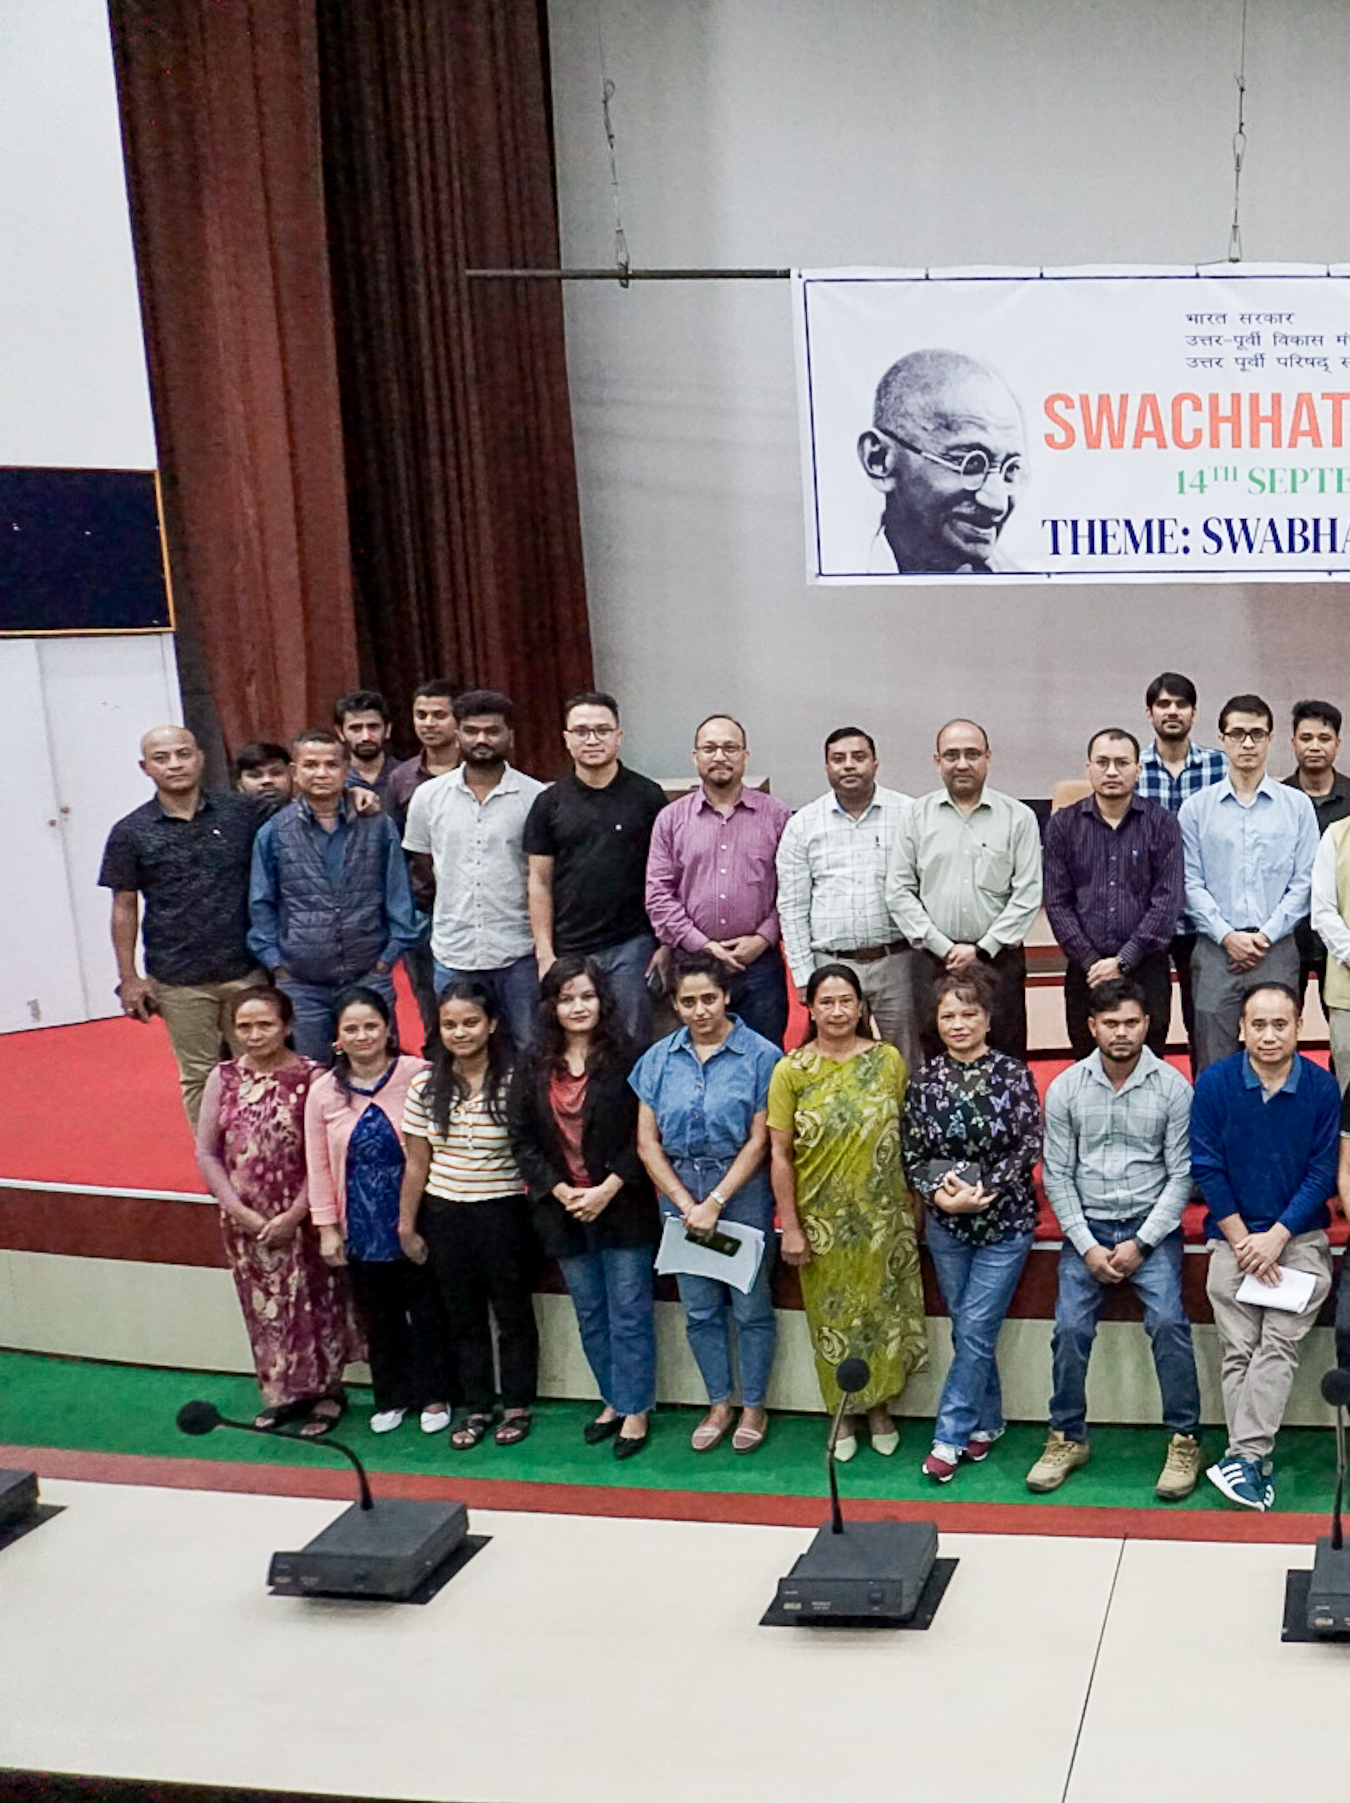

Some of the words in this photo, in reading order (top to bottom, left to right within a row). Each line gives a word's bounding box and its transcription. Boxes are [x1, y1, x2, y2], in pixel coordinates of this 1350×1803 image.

[1185, 312, 1227, 325] भारत
[1239, 312, 1294, 325] सरकार
[1185, 331, 1261, 350] उत्तर-पूर्वी
[1273, 331, 1324, 347] विकास
[1185, 354, 1224, 369] उत्तर
[1234, 353, 1265, 372] पूर्वी
[1276, 353, 1331, 373] परिषद्
[1177, 465, 1239, 494] 14TH
[1042, 518, 1190, 555] THEME:
